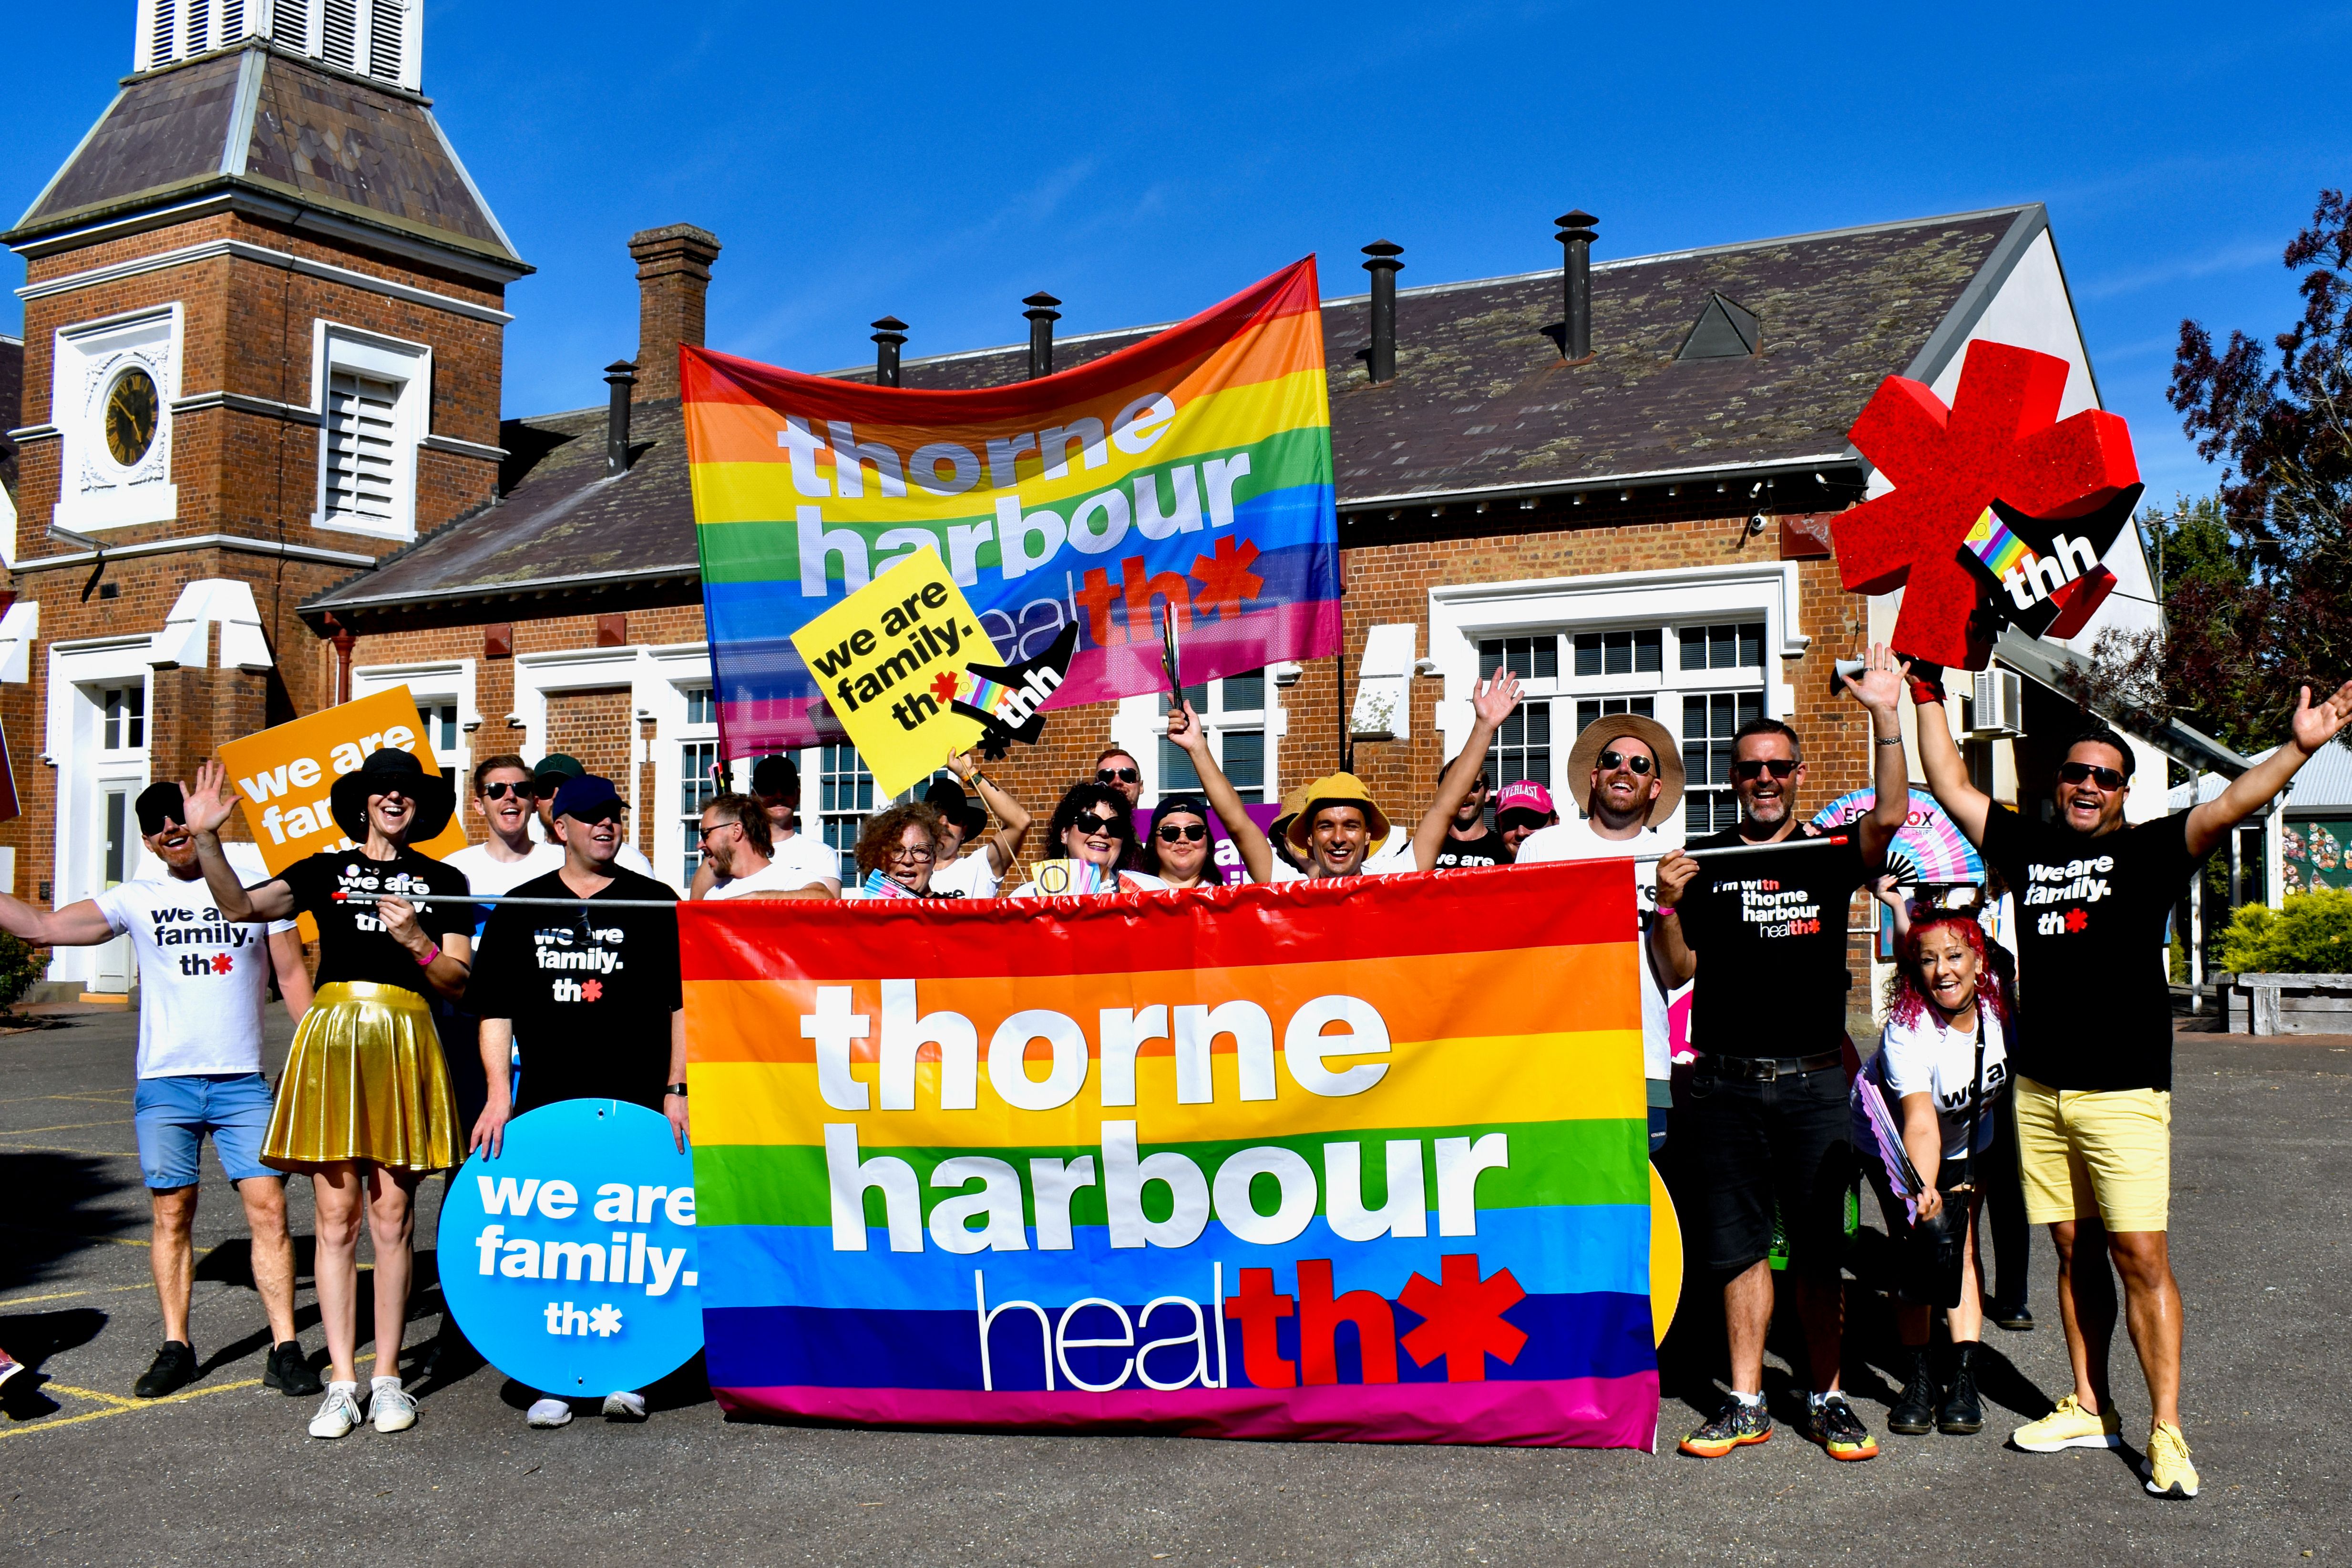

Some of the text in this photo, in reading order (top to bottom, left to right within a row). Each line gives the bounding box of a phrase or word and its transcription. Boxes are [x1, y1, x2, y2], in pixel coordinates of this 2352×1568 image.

[778, 391, 1176, 499] thorne
[2002, 533, 2098, 611] thh
[977, 534, 1265, 666] ealth
[812, 581, 948, 679] we are
[836, 616, 974, 713] family.
[996, 666, 1064, 729] thh
[238, 758, 322, 804] we
[1501, 784, 1538, 802] EVERLAST
[1460, 855, 1495, 867] are
[2028, 855, 2114, 881] we are
[337, 875, 430, 895] we are
[1713, 878, 1779, 893] I'm with
[1741, 890, 1808, 906] thorne
[2023, 876, 2112, 906] family.
[150, 907, 195, 924] we
[1742, 905, 1820, 922] harbour
[154, 922, 254, 948] family.
[534, 928, 574, 946] we
[535, 946, 624, 974] family.
[800, 978, 1392, 1110] thorne
[476, 1175, 697, 1226] we are
[823, 1120, 1509, 1253] harbour
[475, 1224, 698, 1296] family.
